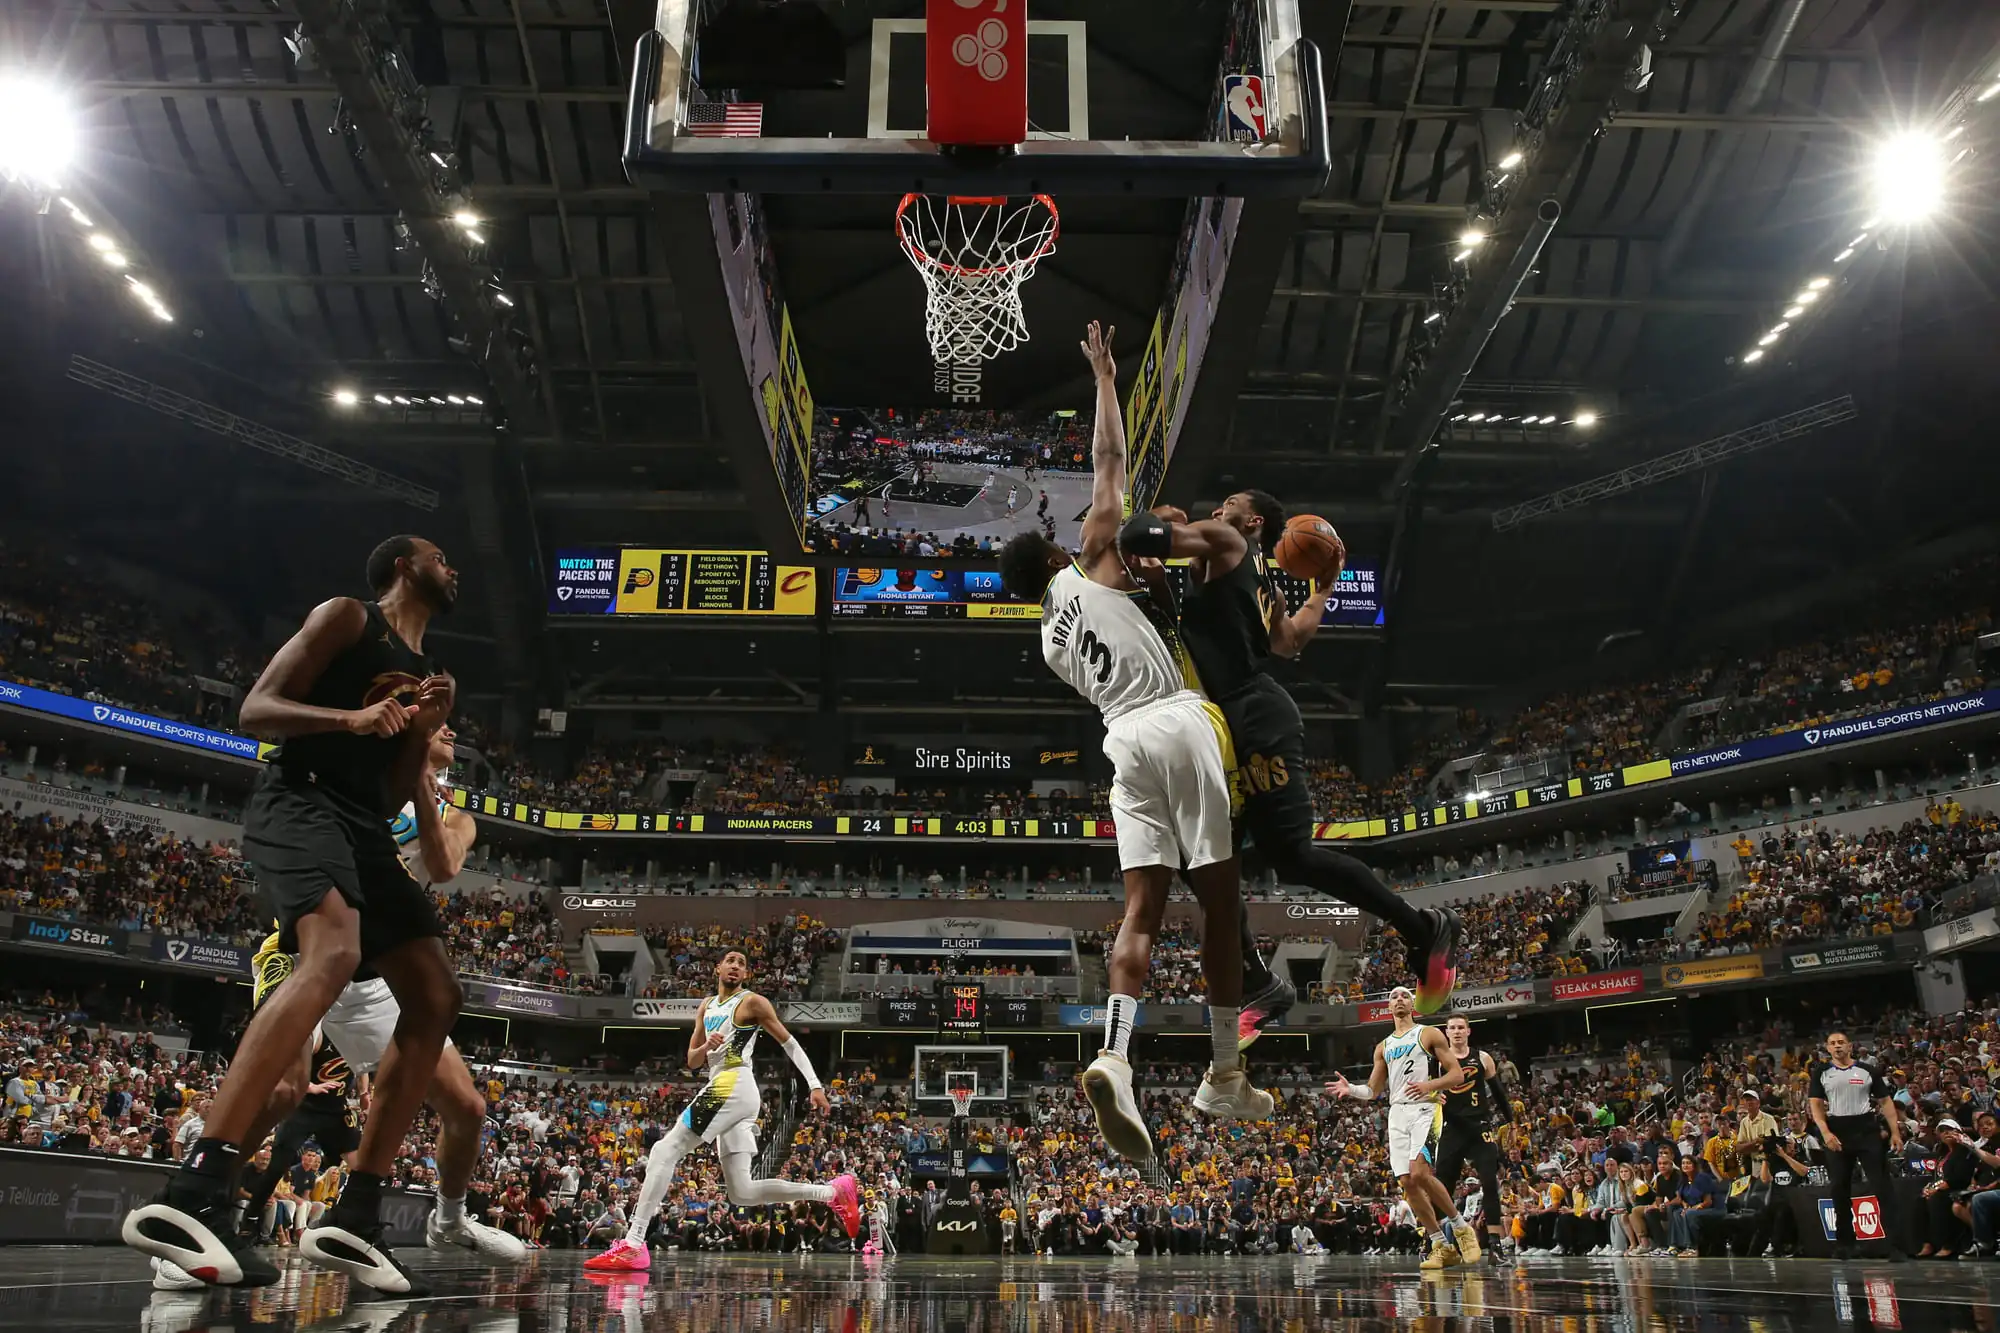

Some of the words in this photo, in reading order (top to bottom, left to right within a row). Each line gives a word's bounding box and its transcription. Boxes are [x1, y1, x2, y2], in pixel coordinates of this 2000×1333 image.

[1234, 129, 1252, 141] NBA
[560, 558, 593, 569] WATCH
[596, 559, 615, 570] THE
[559, 570, 596, 581] PACERS
[598, 570, 613, 581] ON
[1356, 571, 1375, 581] THE
[974, 576, 992, 588] 1.6
[1361, 582, 1375, 593] ON
[999, 607, 1025, 616] PLAYOFFS
[1052, 595, 1083, 648] BRYANT
[1081, 629, 1112, 684] 3
[1822, 720, 1877, 740] FANDUEL
[1876, 709, 1923, 727] SPORTS
[1923, 696, 1985, 718] NETWORK
[111, 712, 163, 732] FANDUEL
[163, 724, 205, 743] SPORTS
[206, 735, 256, 754] NETWORK
[915, 747, 949, 769] Sire
[955, 748, 1011, 773] Spirits
[1690, 748, 1741, 767] NETWORK
[27, 784, 52, 794] NEED
[1593, 779, 1612, 791] 2/6
[1540, 790, 1557, 802] 5/6
[47, 796, 91, 812] LOCATION
[471, 800, 479, 809] 3
[1485, 801, 1507, 813] 2/11
[503, 807, 509, 816] 9
[1453, 811, 1459, 820] 2
[533, 815, 539, 823] 9
[643, 820, 649, 829] 6
[727, 819, 770, 829] INDIANA
[772, 820, 813, 830] PACERS
[1422, 817, 1428, 826] 2
[675, 821, 683, 830] 4
[863, 819, 881, 832] 24
[912, 824, 924, 833] 14
[955, 821, 987, 833] 4:03
[1012, 826, 1017, 834] 1
[1052, 822, 1068, 835] 11
[1393, 823, 1398, 832] 5
[582, 898, 637, 907] LEXUS
[1306, 907, 1360, 915] LEXUS
[942, 939, 981, 948] FLIGHT
[1847, 944, 1879, 954] DRIVING
[192, 945, 240, 960] FANDUEL
[1825, 950, 1882, 964] SUSTAINABILITY
[1554, 982, 1590, 995] STEAK
[1599, 976, 1638, 990] SHAKE
[953, 987, 978, 998] 4:02
[517, 995, 553, 1008] DONUTS
[1452, 993, 1503, 1008] KeyBank
[890, 1002, 917, 1011] PACERS
[956, 998, 976, 1018] 14
[1008, 1003, 1027, 1011] CAVS
[898, 1012, 910, 1022] 24
[1403, 1059, 1414, 1075] 2
[1471, 1091, 1478, 1107] 5
[953, 1149, 963, 1158] GET
[953, 1159, 963, 1167] THE
[8, 1186, 60, 1206] Telluride
[947, 1198, 970, 1207] Google
[1858, 1212, 1878, 1226] TNT
